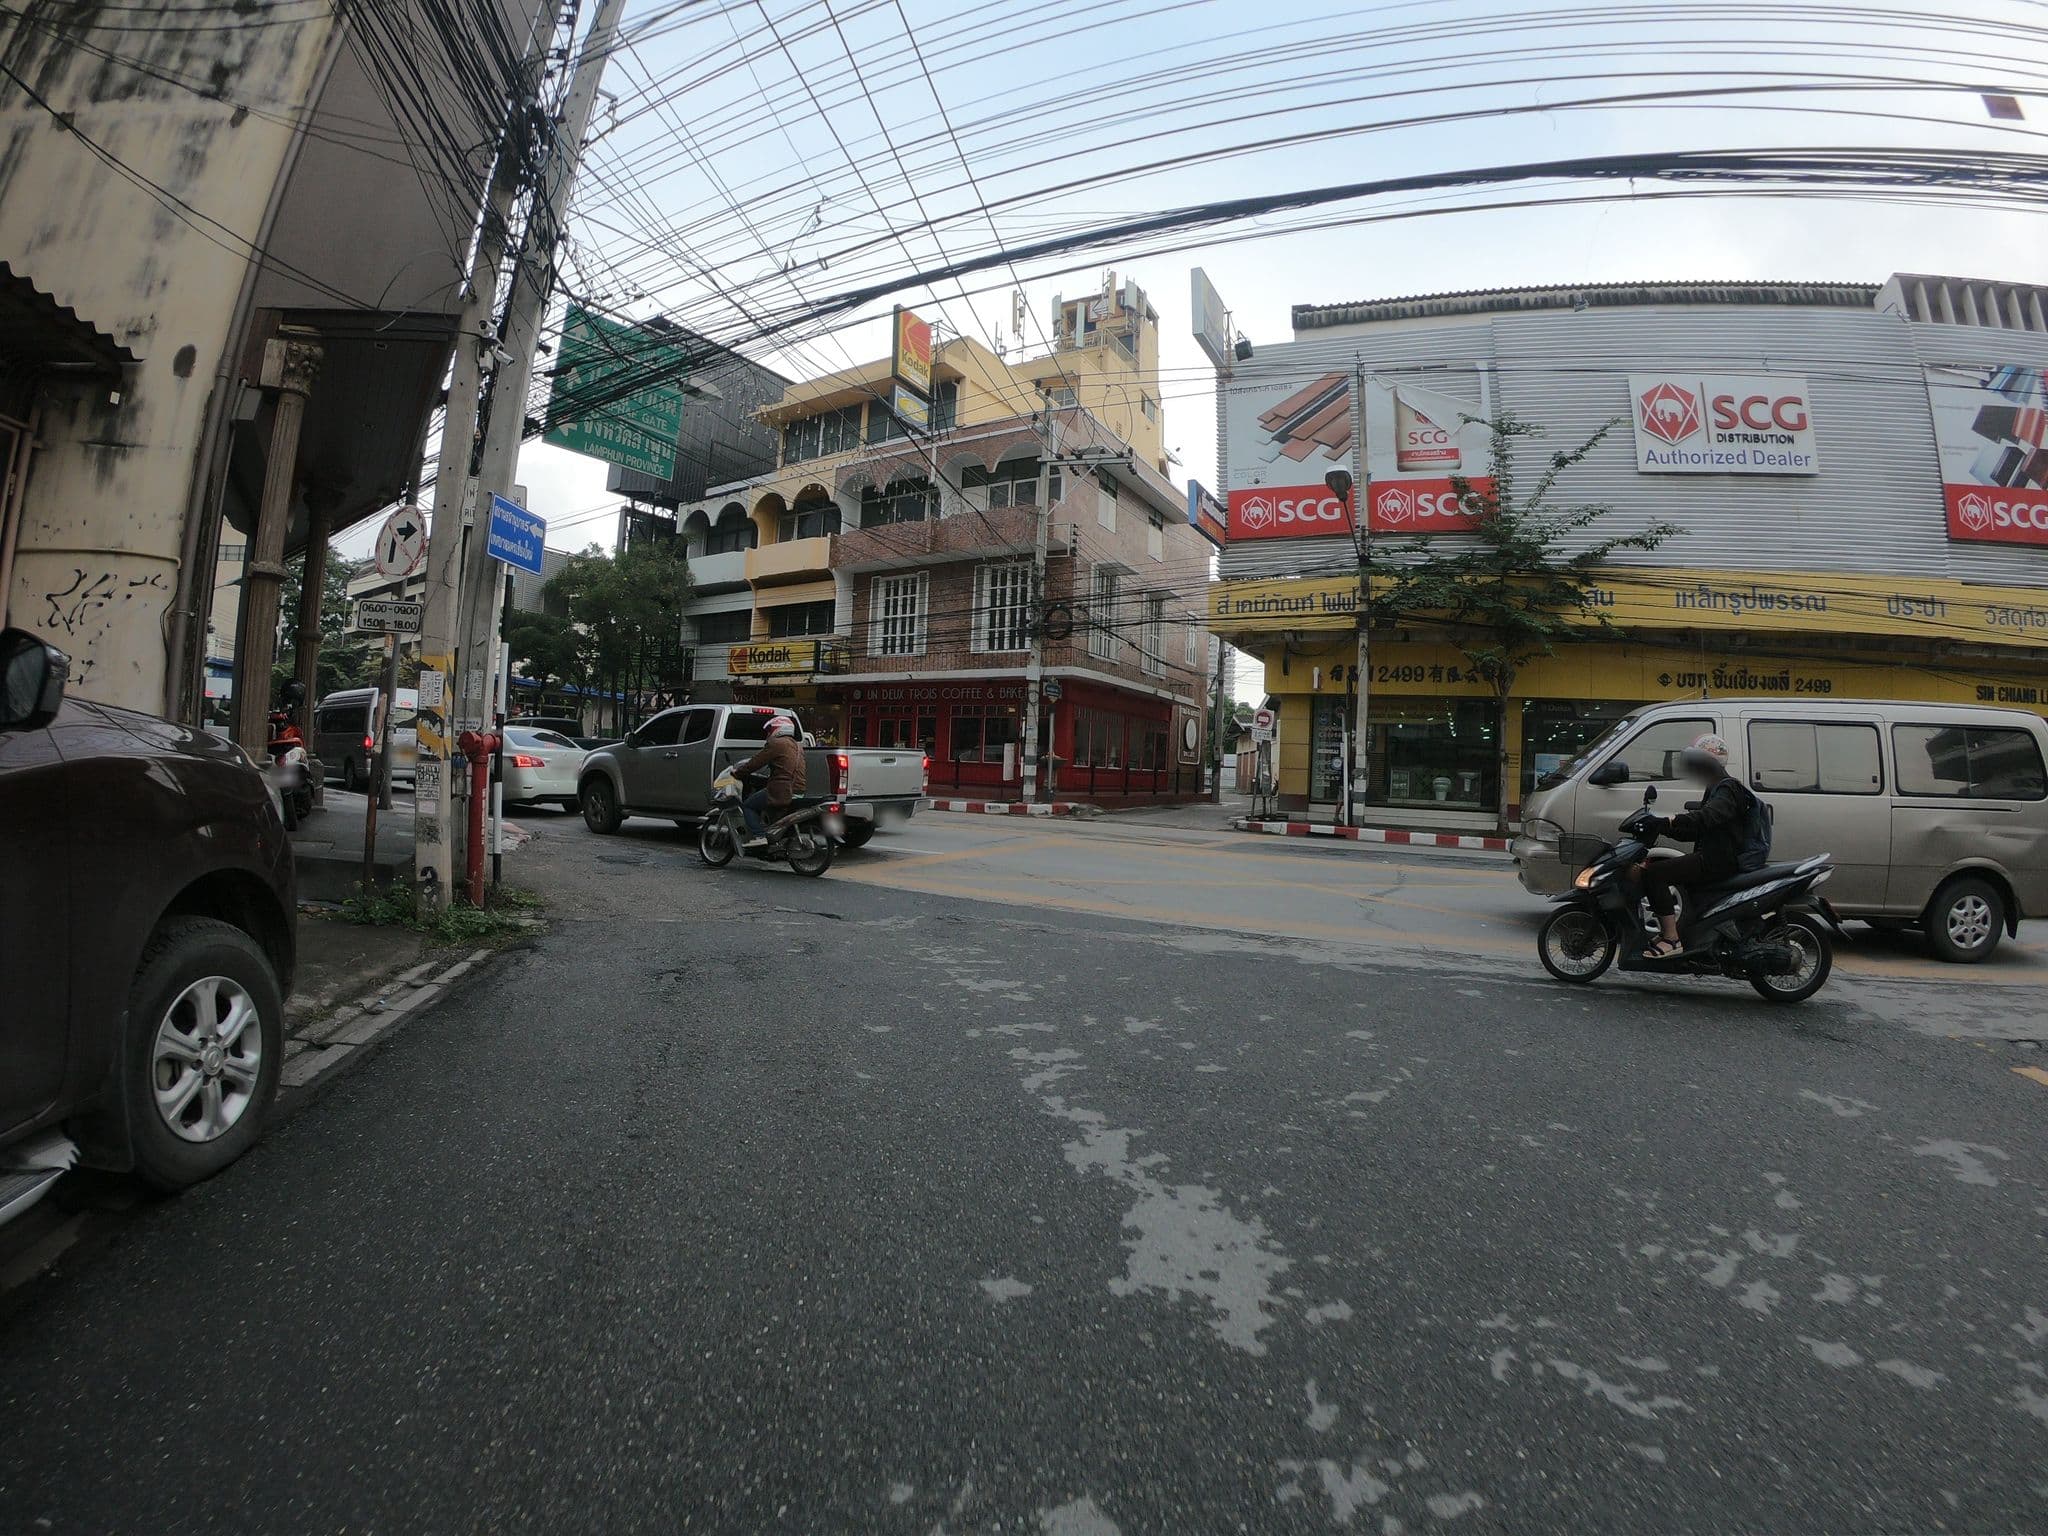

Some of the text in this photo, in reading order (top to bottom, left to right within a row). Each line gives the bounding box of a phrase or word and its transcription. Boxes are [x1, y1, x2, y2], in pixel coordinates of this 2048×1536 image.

[902, 351, 929, 379] Kodak
[642, 412, 668, 430] GATE
[1712, 394, 1808, 431] SCG
[1408, 430, 1448, 445] SCG
[1716, 433, 1795, 444] DISTRIBUTION
[584, 441, 665, 475] LAMPHUN PROVINCE
[1645, 449, 1811, 467] Authorized Dealer
[1278, 498, 1341, 522] SCG
[1993, 502, 2048, 530] SCG
[1217, 593, 1229, 614] สี
[1236, 592, 1315, 614] เคมีภัณฑ์
[1676, 584, 1828, 616] เหล็กรูปพรรณ
[1887, 593, 1946, 618] ประปา
[749, 646, 791, 664] Kodak
[749, 661, 793, 670] express
[867, 689, 878, 700] UN
[882, 689, 904, 700] DEUX
[909, 688, 937, 700] TROIS
[942, 687, 984, 700] COFFEE
[987, 688, 994, 699] &
[1795, 678, 1832, 694] 2499
[1976, 685, 2048, 705] SIN CHIANG L
[733, 693, 757, 704] VISA
